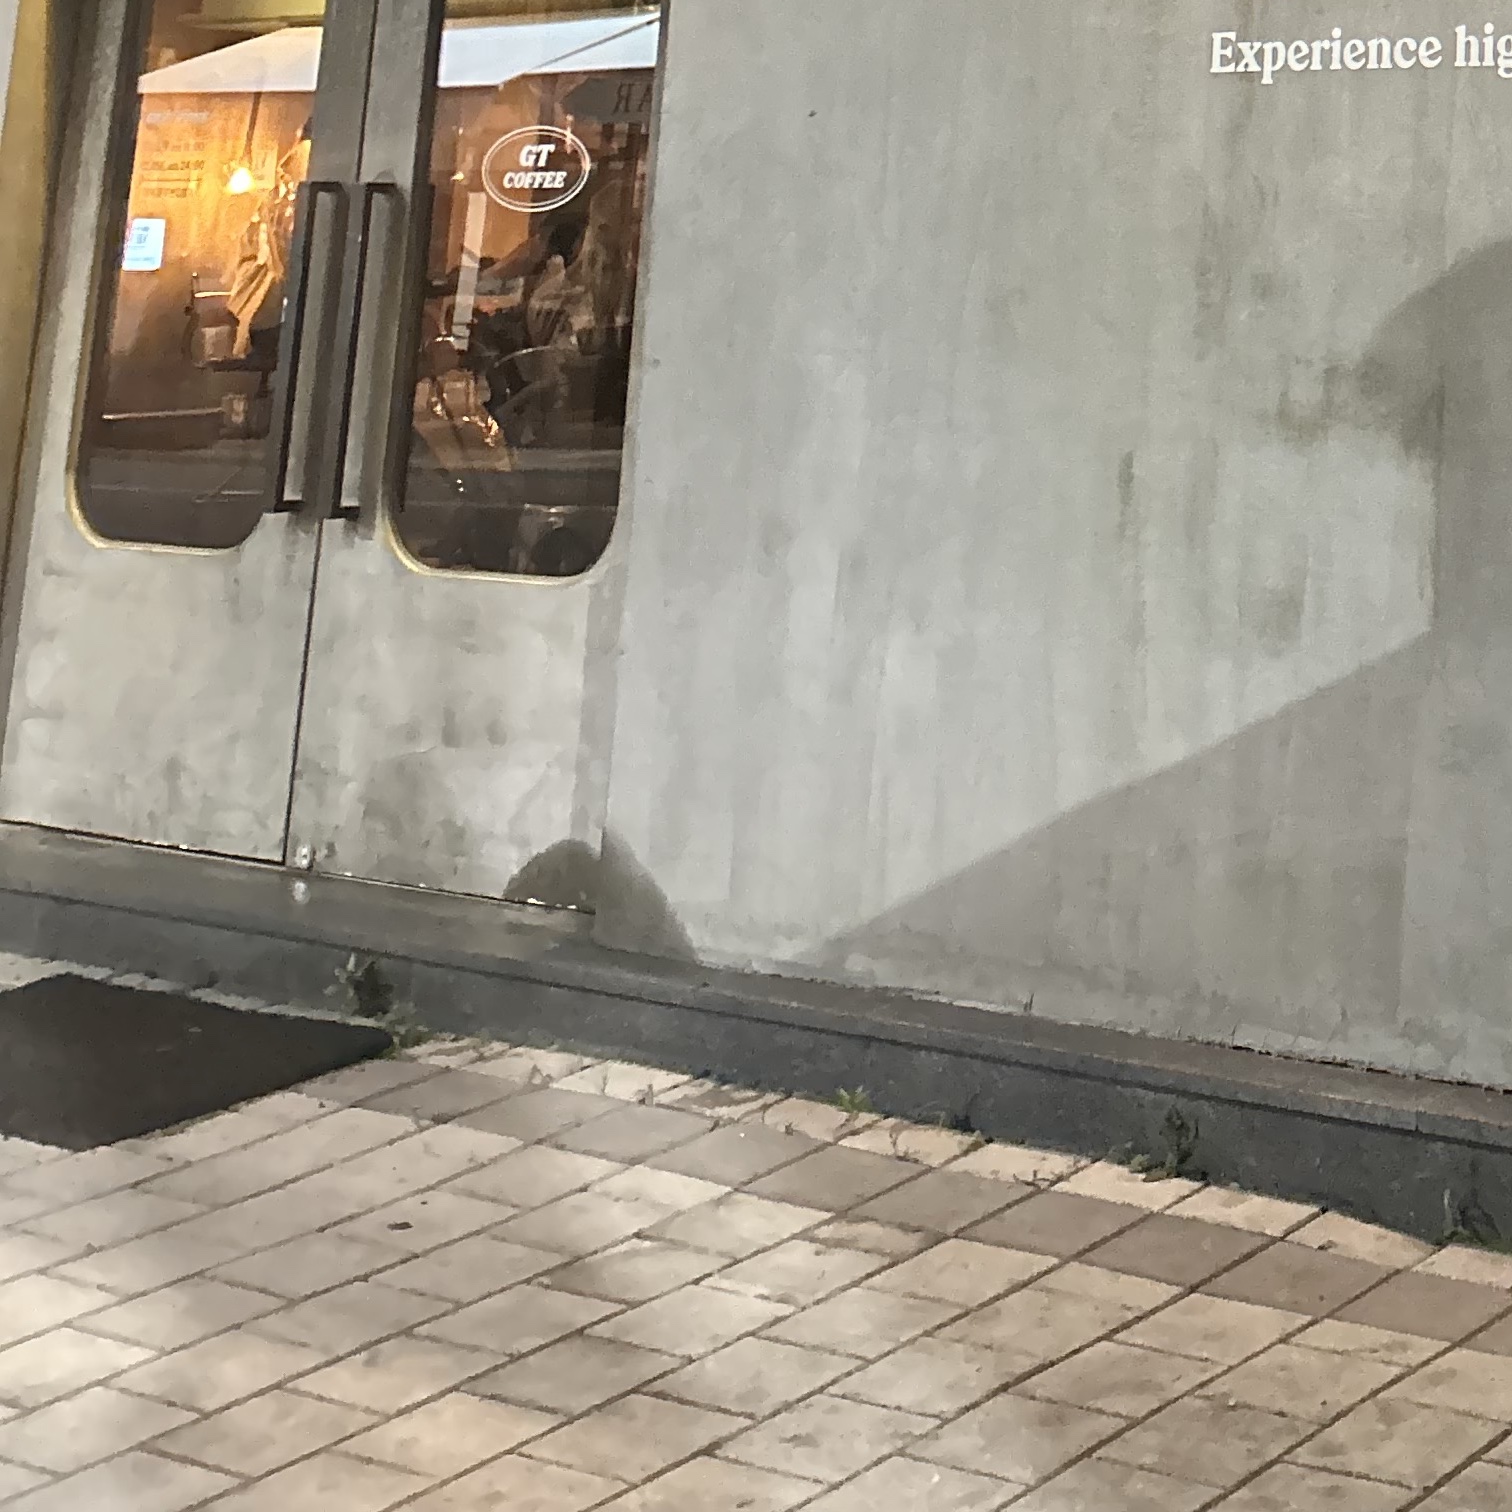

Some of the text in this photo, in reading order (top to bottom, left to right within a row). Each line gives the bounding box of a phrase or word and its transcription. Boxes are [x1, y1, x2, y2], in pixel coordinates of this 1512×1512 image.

[1210, 26, 1443, 85] Experience
[519, 144, 556, 168] GT
[502, 170, 568, 189] COFFEE
